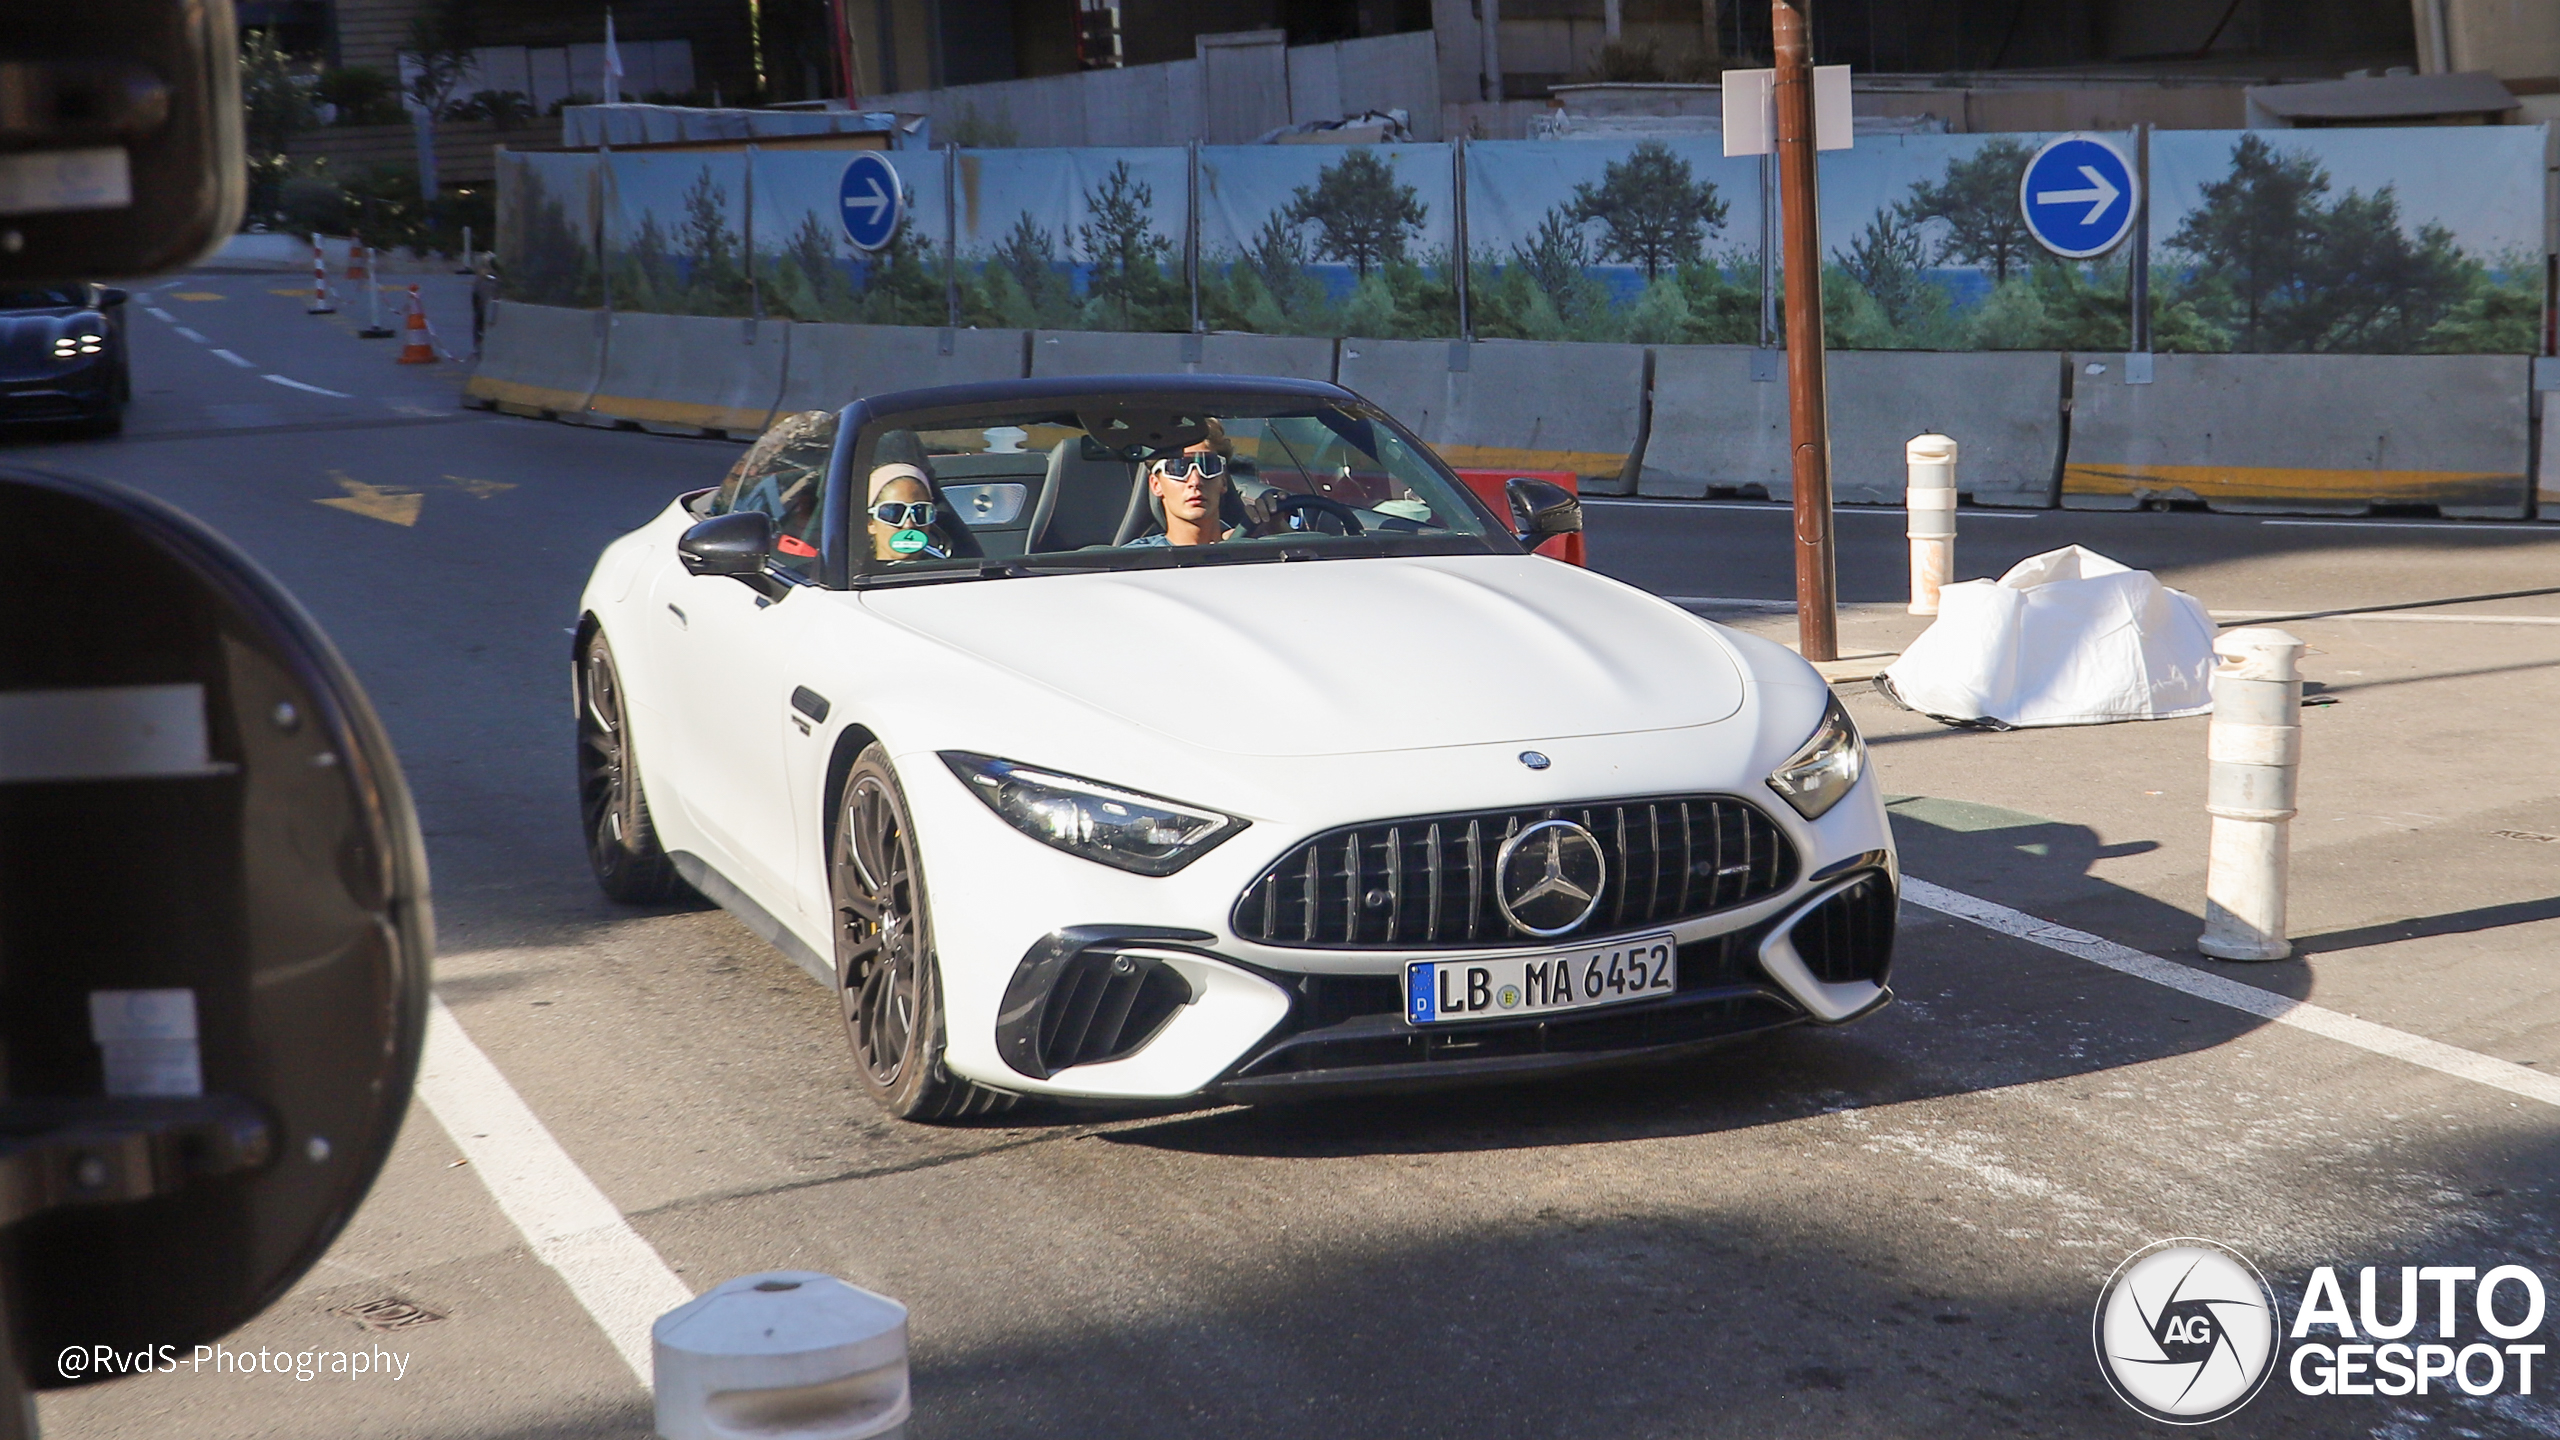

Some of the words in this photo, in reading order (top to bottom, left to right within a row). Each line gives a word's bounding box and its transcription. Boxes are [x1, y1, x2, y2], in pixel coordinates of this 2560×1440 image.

[1439, 967, 1491, 1013] LB
[1525, 960, 1574, 1006] MA
[1584, 944, 1670, 998] 6452
[1416, 998, 1427, 1011] D
